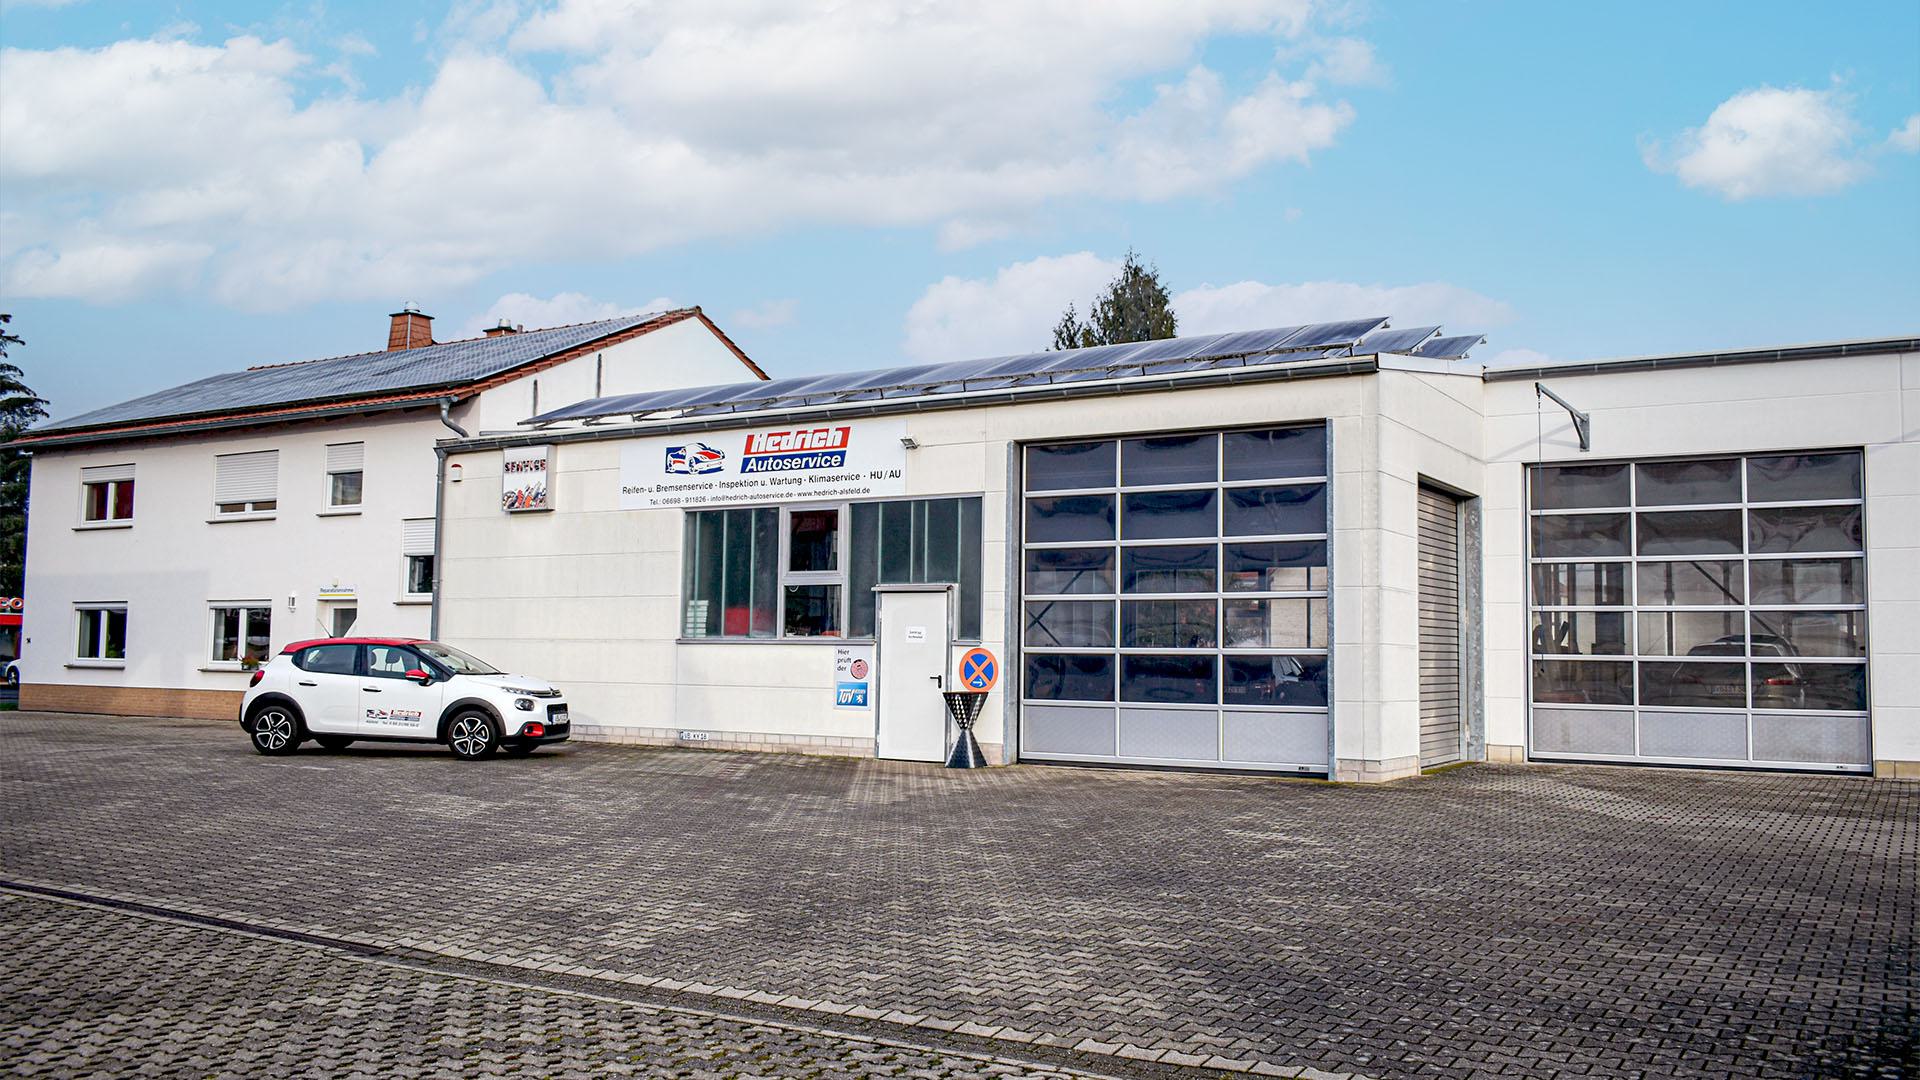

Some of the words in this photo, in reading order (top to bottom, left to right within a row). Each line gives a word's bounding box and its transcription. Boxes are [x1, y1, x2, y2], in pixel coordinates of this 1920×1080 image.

[749, 428, 845, 453] Hedrich
[745, 453, 842, 472] Autoservice
[622, 485, 648, 495] Reifen-
[648, 485, 655, 494] u.
[656, 481, 714, 494] Bremsenservice
[719, 477, 759, 490] Inspektion
[769, 475, 803, 487] Wartung
[808, 471, 861, 484] Klimaservice
